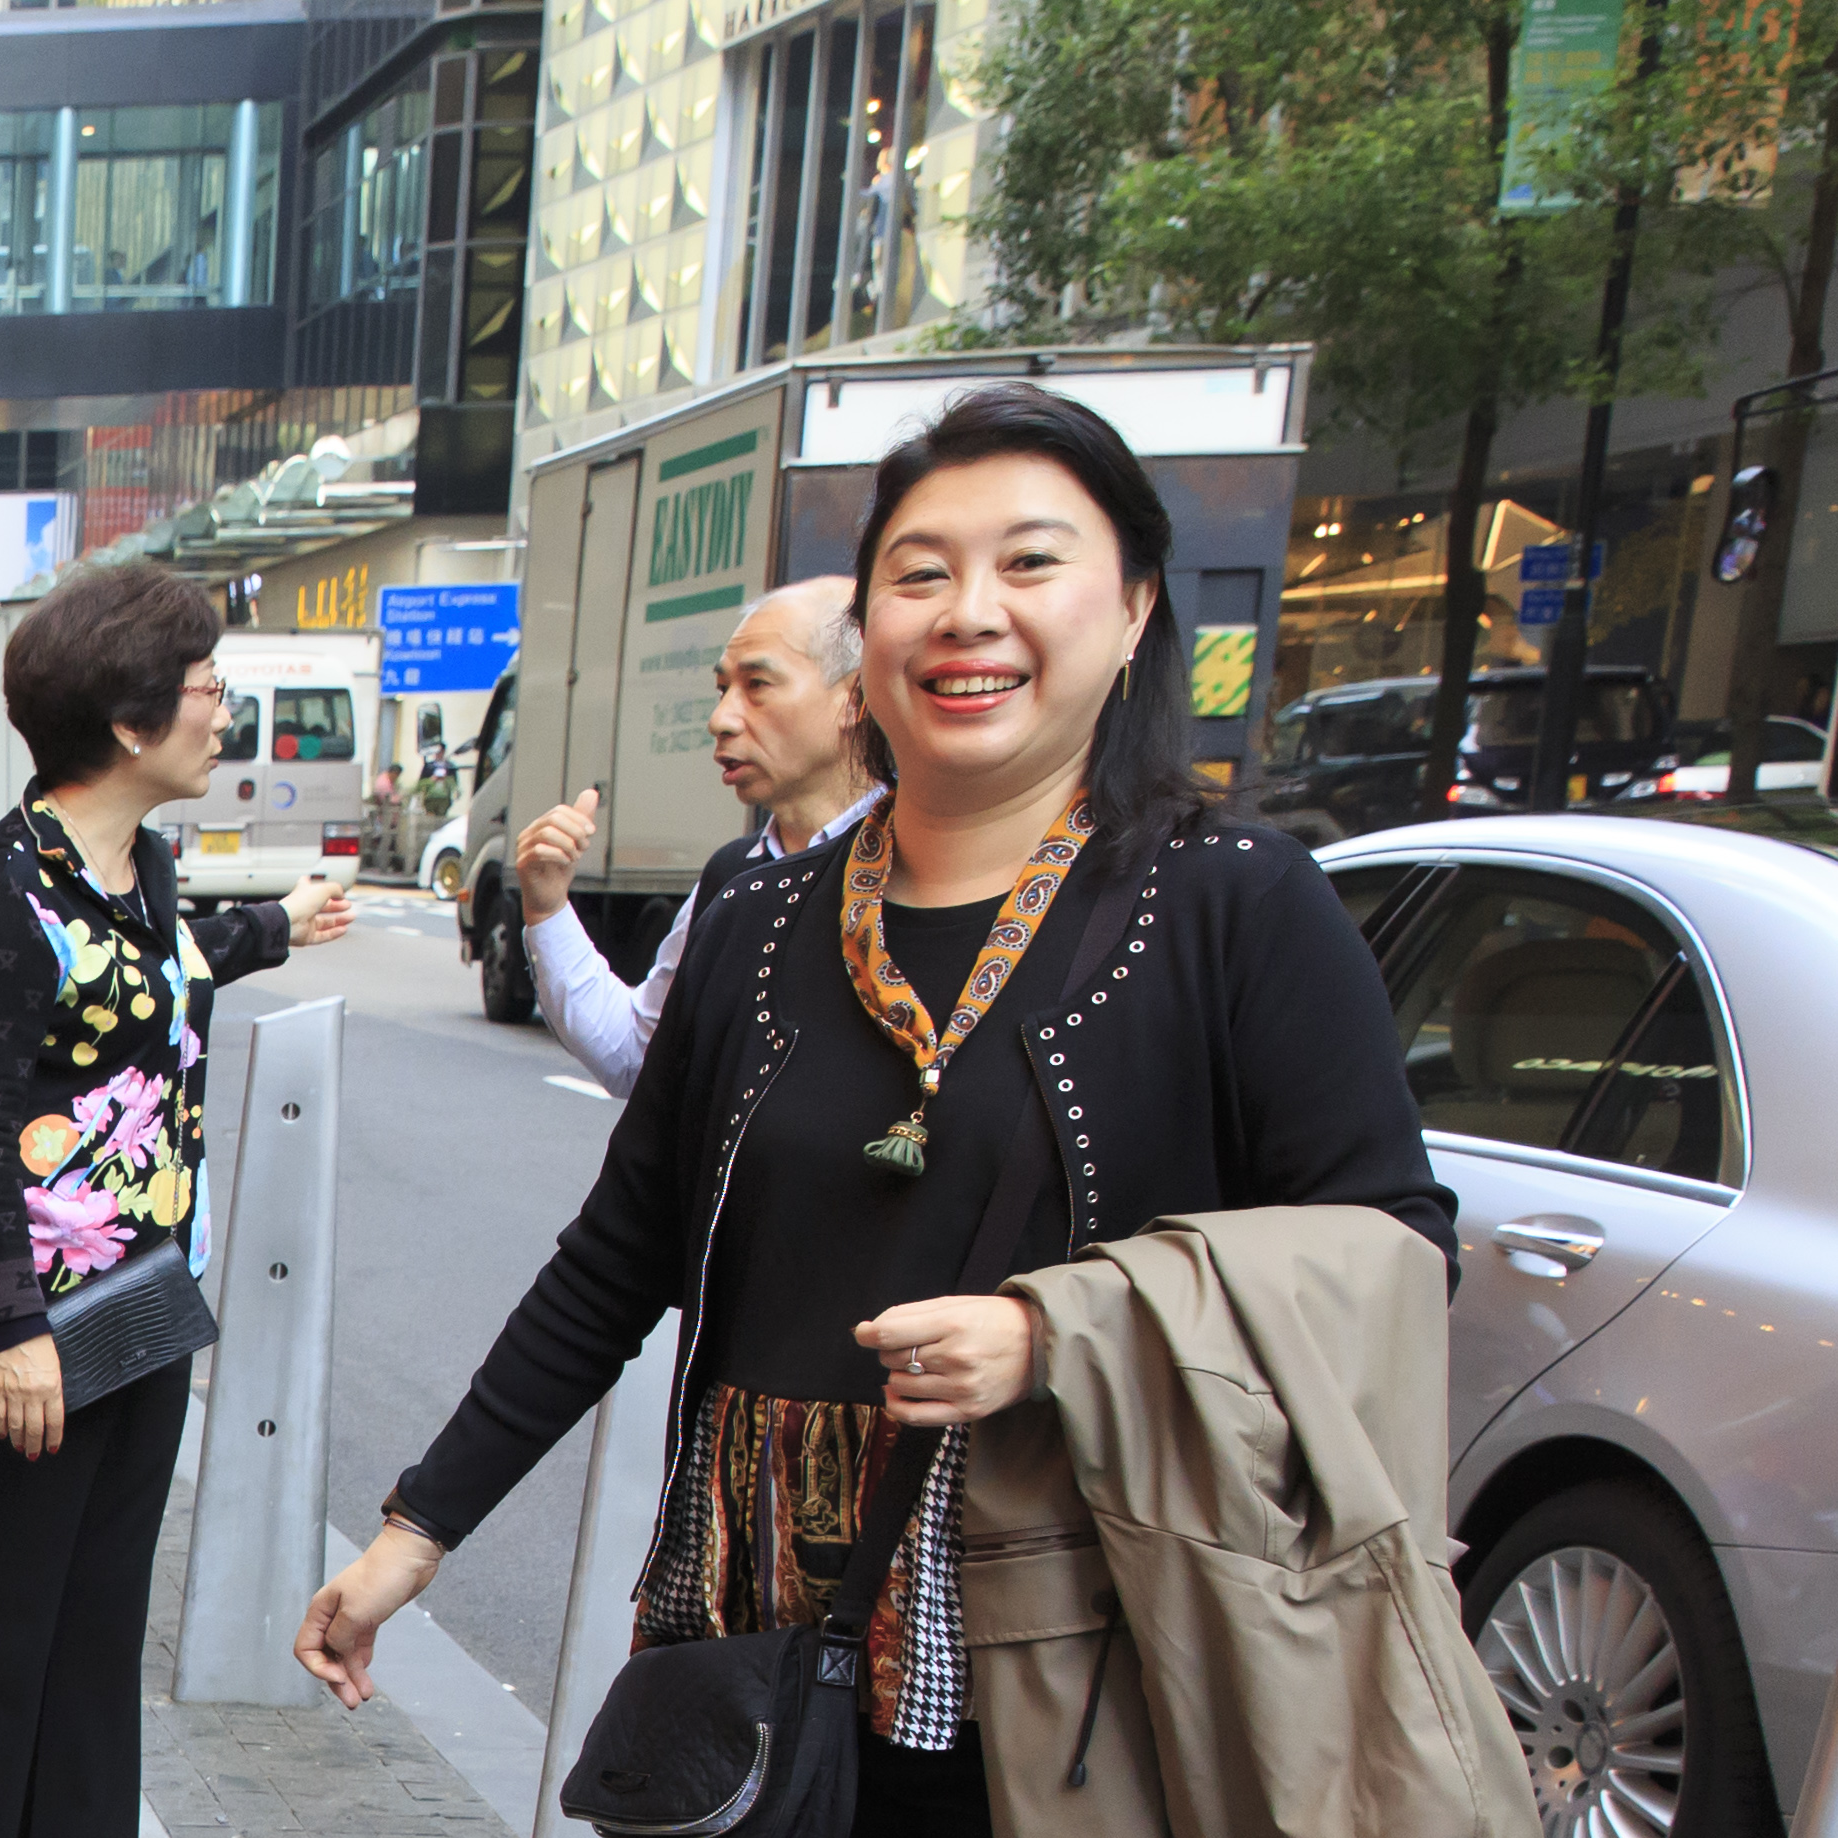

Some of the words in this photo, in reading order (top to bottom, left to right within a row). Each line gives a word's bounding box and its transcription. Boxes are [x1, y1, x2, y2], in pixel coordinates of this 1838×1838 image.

[648, 470, 755, 587] EASYDIY
[386, 593, 435, 609] Airport
[438, 590, 497, 608] Express
